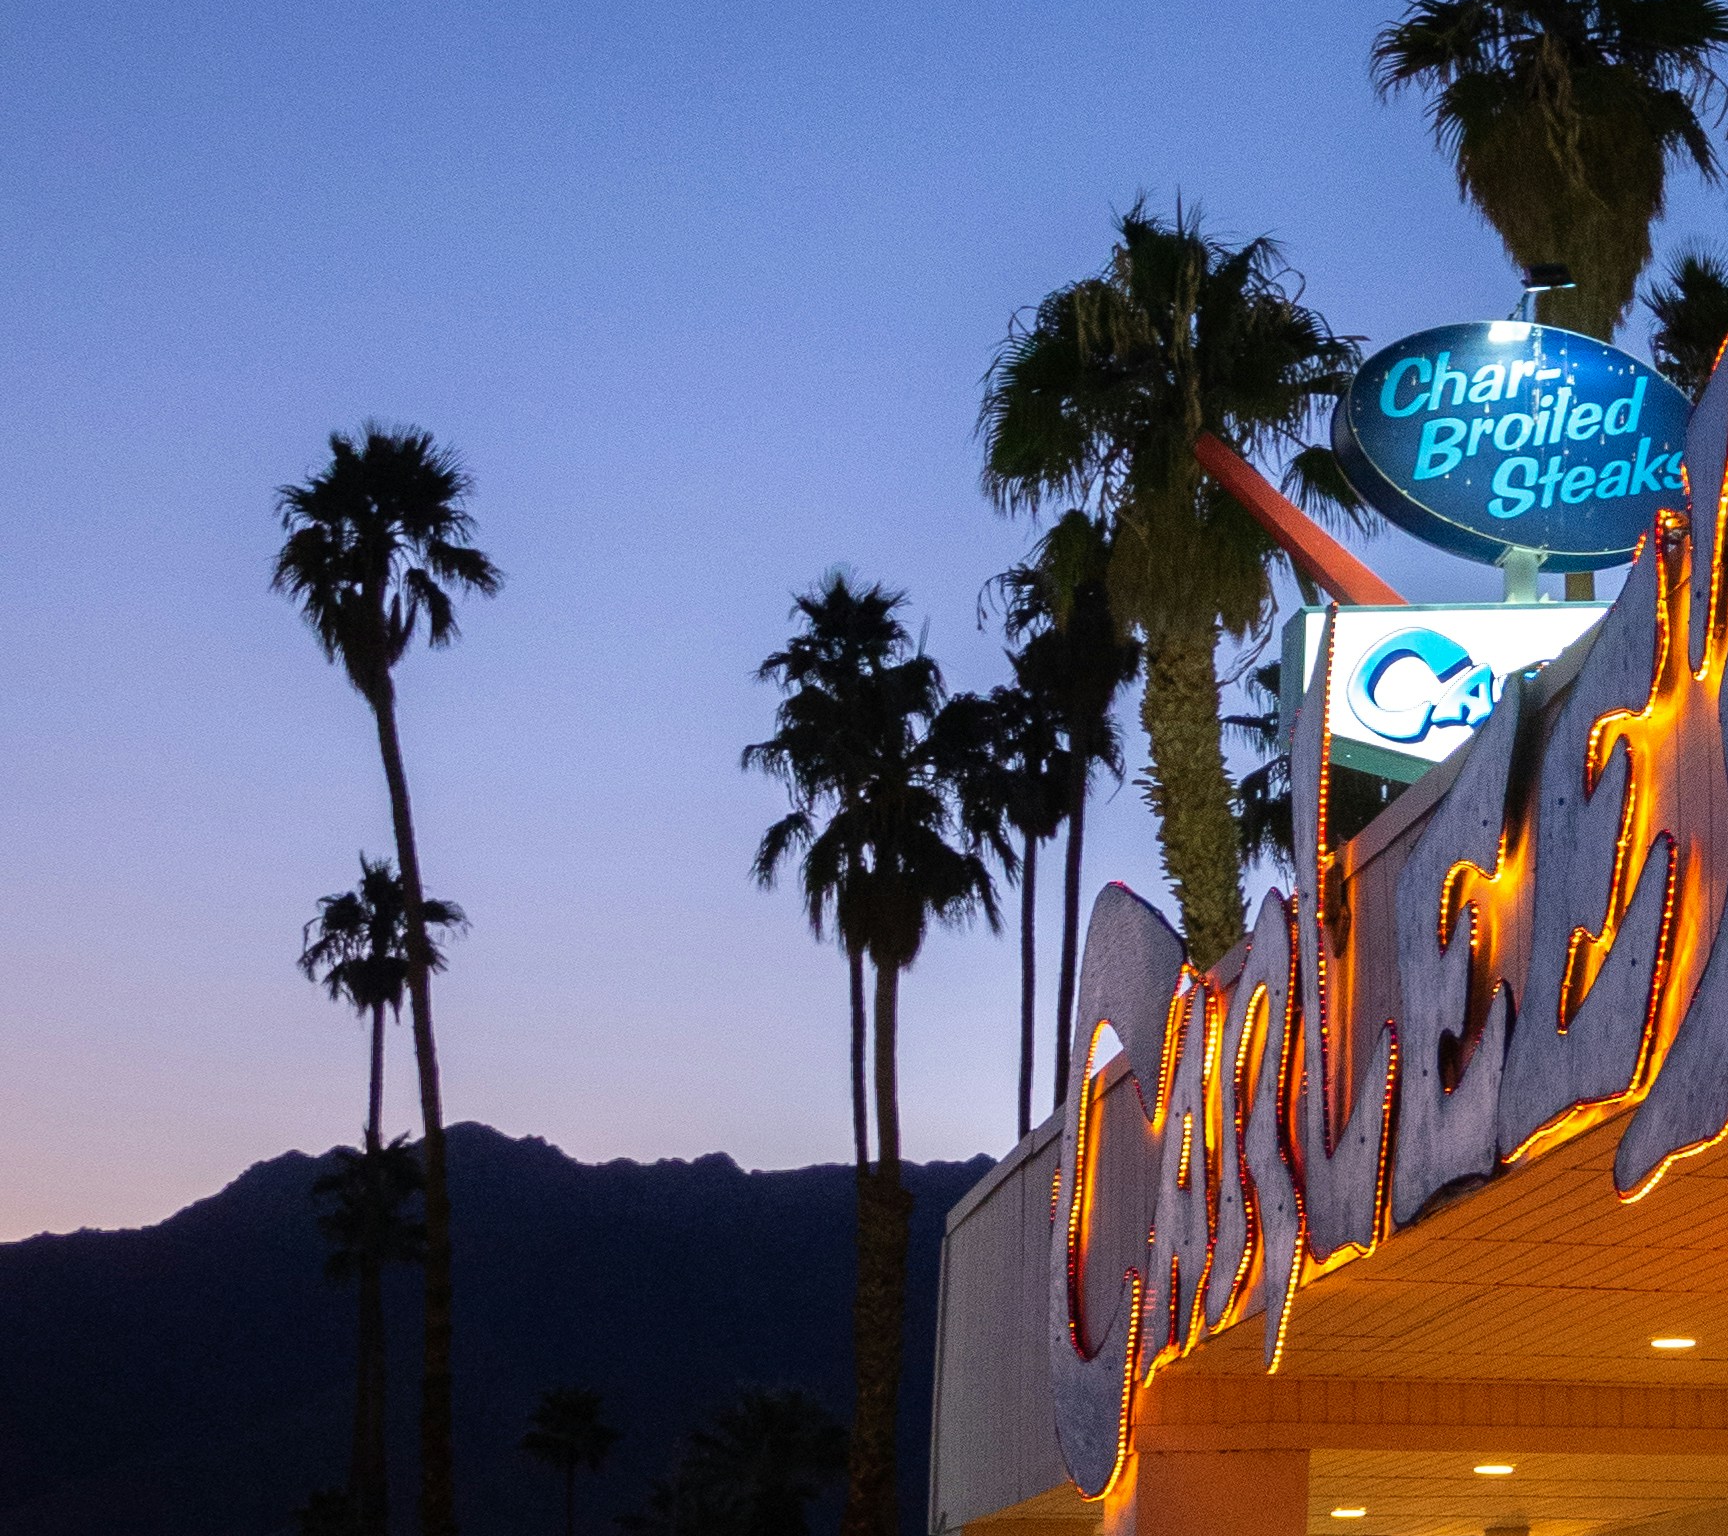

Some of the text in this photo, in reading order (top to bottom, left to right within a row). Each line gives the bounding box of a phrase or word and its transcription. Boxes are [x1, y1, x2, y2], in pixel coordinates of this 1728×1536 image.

[1378, 350, 1563, 420] Char-
[1412, 374, 1649, 482] Broiled
[1487, 437, 1685, 521] Steaks
